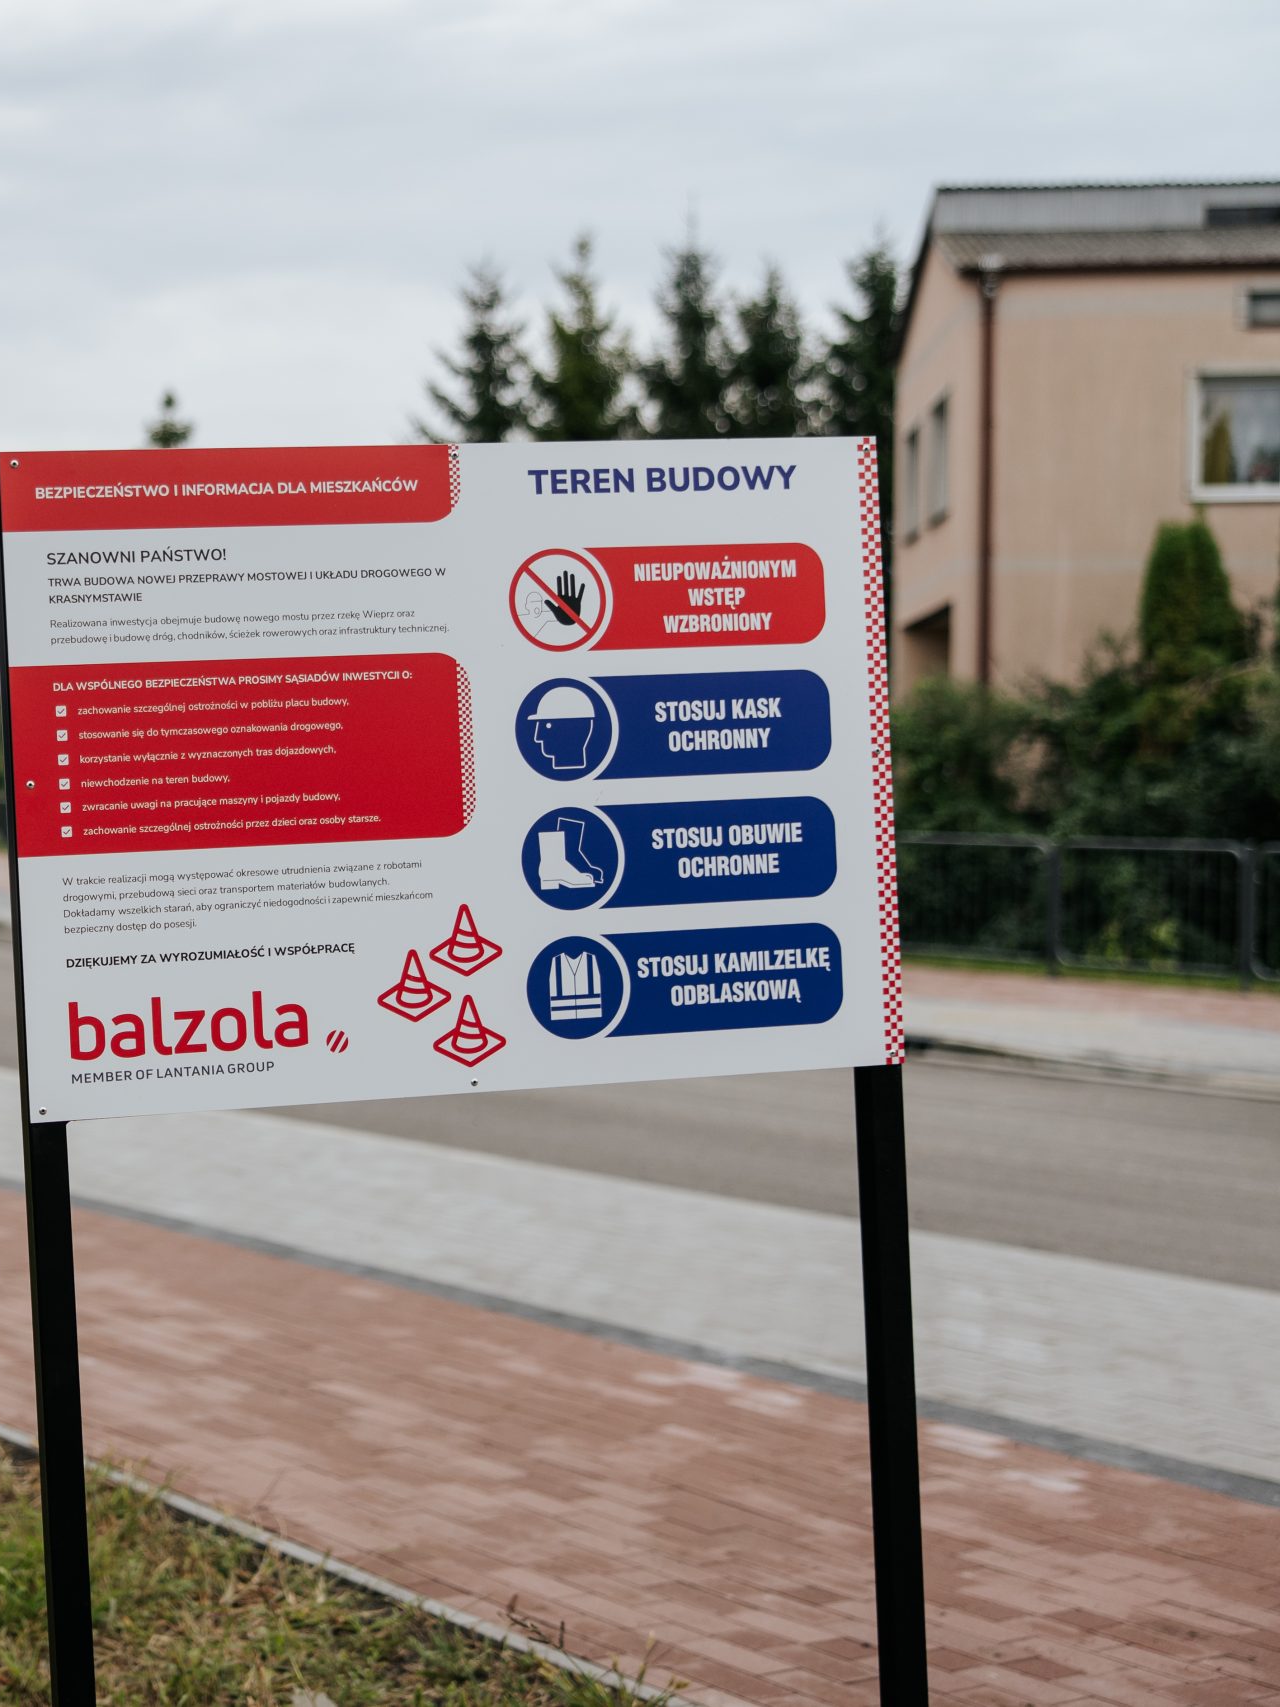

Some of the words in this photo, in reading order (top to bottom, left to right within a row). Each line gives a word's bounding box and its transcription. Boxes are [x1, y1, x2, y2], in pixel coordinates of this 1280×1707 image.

[34, 481, 169, 499] BEZPIECZEŃSTWO
[181, 482, 274, 496] INFORMACJA
[277, 481, 306, 494] DLA
[309, 476, 417, 493] MIESZKAŃCÓW
[527, 468, 634, 494] TEREN
[646, 464, 796, 492] BUDOWY
[46, 550, 135, 565] SZANOWNI
[140, 545, 226, 562] PAŃSTWO!
[47, 577, 81, 587] TRWA
[83, 576, 134, 586] BUDOWA
[137, 574, 175, 584] NOWEJ
[178, 572, 244, 583] PRZEPRAWY
[247, 571, 306, 581] MOSTOWEJ
[315, 569, 357, 579] UKŁADU
[360, 567, 431, 578] DROGOWEGO
[434, 567, 445, 576] W
[633, 556, 796, 581] NIEUPOWAŻNIONYM
[48, 592, 142, 604] KRASNYMSTAWIE
[687, 587, 745, 610] WSTĘP
[49, 619, 107, 628] Realizowana
[109, 616, 157, 627] inwestycja
[160, 615, 201, 626] obejmuje
[204, 614, 240, 624] budowę
[243, 614, 279, 623] nowego
[282, 612, 309, 621] mostu
[311, 613, 335, 622] przez
[337, 610, 360, 620] rzekę
[362, 609, 394, 619] Wieprz
[663, 612, 772, 633] WZBRONIONY
[50, 634, 107, 645] przebudowę
[113, 633, 150, 642] budowę
[228, 629, 260, 638] ścieżek
[262, 627, 317, 637] rowerowych
[338, 625, 396, 635] infrastruktury
[52, 682, 73, 691] DLA
[75, 678, 142, 690] WSPÓLNEGO
[145, 675, 236, 688] BEZPIECZEŃSTWA
[238, 674, 283, 685] PROSIMY
[284, 670, 339, 685] SĄSIADÓW
[342, 670, 399, 681] INWESTYCJI
[401, 670, 412, 679] O:
[77, 704, 131, 715] zachowanie
[133, 702, 185, 714] szczególnej
[187, 699, 237, 711] ostrożności
[250, 698, 283, 710] pobliżu
[285, 698, 309, 709] placu
[654, 699, 725, 722] STOSUJ
[731, 697, 781, 719] KASK
[78, 728, 129, 739] stosowanie
[131, 728, 144, 738] się
[146, 727, 158, 736] do
[159, 726, 228, 737] tymczasowego
[230, 722, 287, 733] oznakowania
[668, 727, 770, 752] OCHRONNY
[79, 753, 130, 764] korzystanie
[132, 751, 178, 763] wyłącznie
[187, 747, 253, 760] wyznaczonych
[255, 748, 273, 756] tras
[80, 776, 149, 788] niewchodzenie
[165, 776, 188, 784] teren
[81, 800, 128, 811] zwracanie
[130, 799, 158, 810] uwagi
[174, 797, 217, 808] pracujące
[219, 796, 258, 806] maszyny
[265, 793, 300, 805] pojazdy
[83, 824, 136, 835] zachowanie
[138, 821, 191, 833] szczególnej
[193, 819, 243, 830] ostrożności
[245, 820, 269, 829] przez
[271, 817, 296, 826] dzieci
[298, 817, 317, 825] oraz
[319, 815, 345, 825] osoby
[651, 825, 722, 849] STOSUJ
[728, 822, 802, 845] OBUWIE
[61, 876, 73, 886] W
[76, 875, 105, 885] trakcie
[108, 873, 146, 884] realizacji
[149, 874, 174, 882] mogą
[176, 868, 233, 881] występować
[235, 868, 278, 877] okresowe
[281, 864, 330, 875] utrudnienia
[333, 863, 374, 873] związane
[383, 859, 421, 869] robotami
[678, 853, 779, 878] OCHRONNE
[118, 889, 174, 901] przebudową
[177, 887, 196, 896] sieci
[198, 887, 216, 895] oraz
[219, 884, 274, 894] transportem
[276, 880, 325, 891] materiałów
[63, 908, 115, 918] Dokładamy
[117, 904, 161, 915] wszelkich
[195, 902, 212, 912] aby
[214, 898, 261, 911] ograniczyć
[263, 895, 326, 908] niedogodności
[331, 893, 373, 904] zapewnić
[375, 890, 432, 901] mieszkańcom
[64, 924, 114, 935] bezpieczny
[115, 922, 146, 931] dostęp
[149, 920, 161, 929] do
[66, 954, 137, 969] DZIĘKUJEMY
[140, 954, 156, 964] ZA
[159, 944, 264, 962] WYROZUMIAŁOŚĆ
[273, 942, 355, 956] WSPÓŁPRACĘ
[637, 954, 708, 978] STOSUJ
[714, 946, 830, 973] KAMILZELKĘ
[670, 978, 801, 1006] ODBLASKOWĄ
[68, 990, 308, 1060] balzola
[71, 1070, 132, 1084] MEMBER
[135, 1068, 152, 1080] OF
[156, 1064, 224, 1078] LANTANIA
[227, 1061, 274, 1074] GROUP
